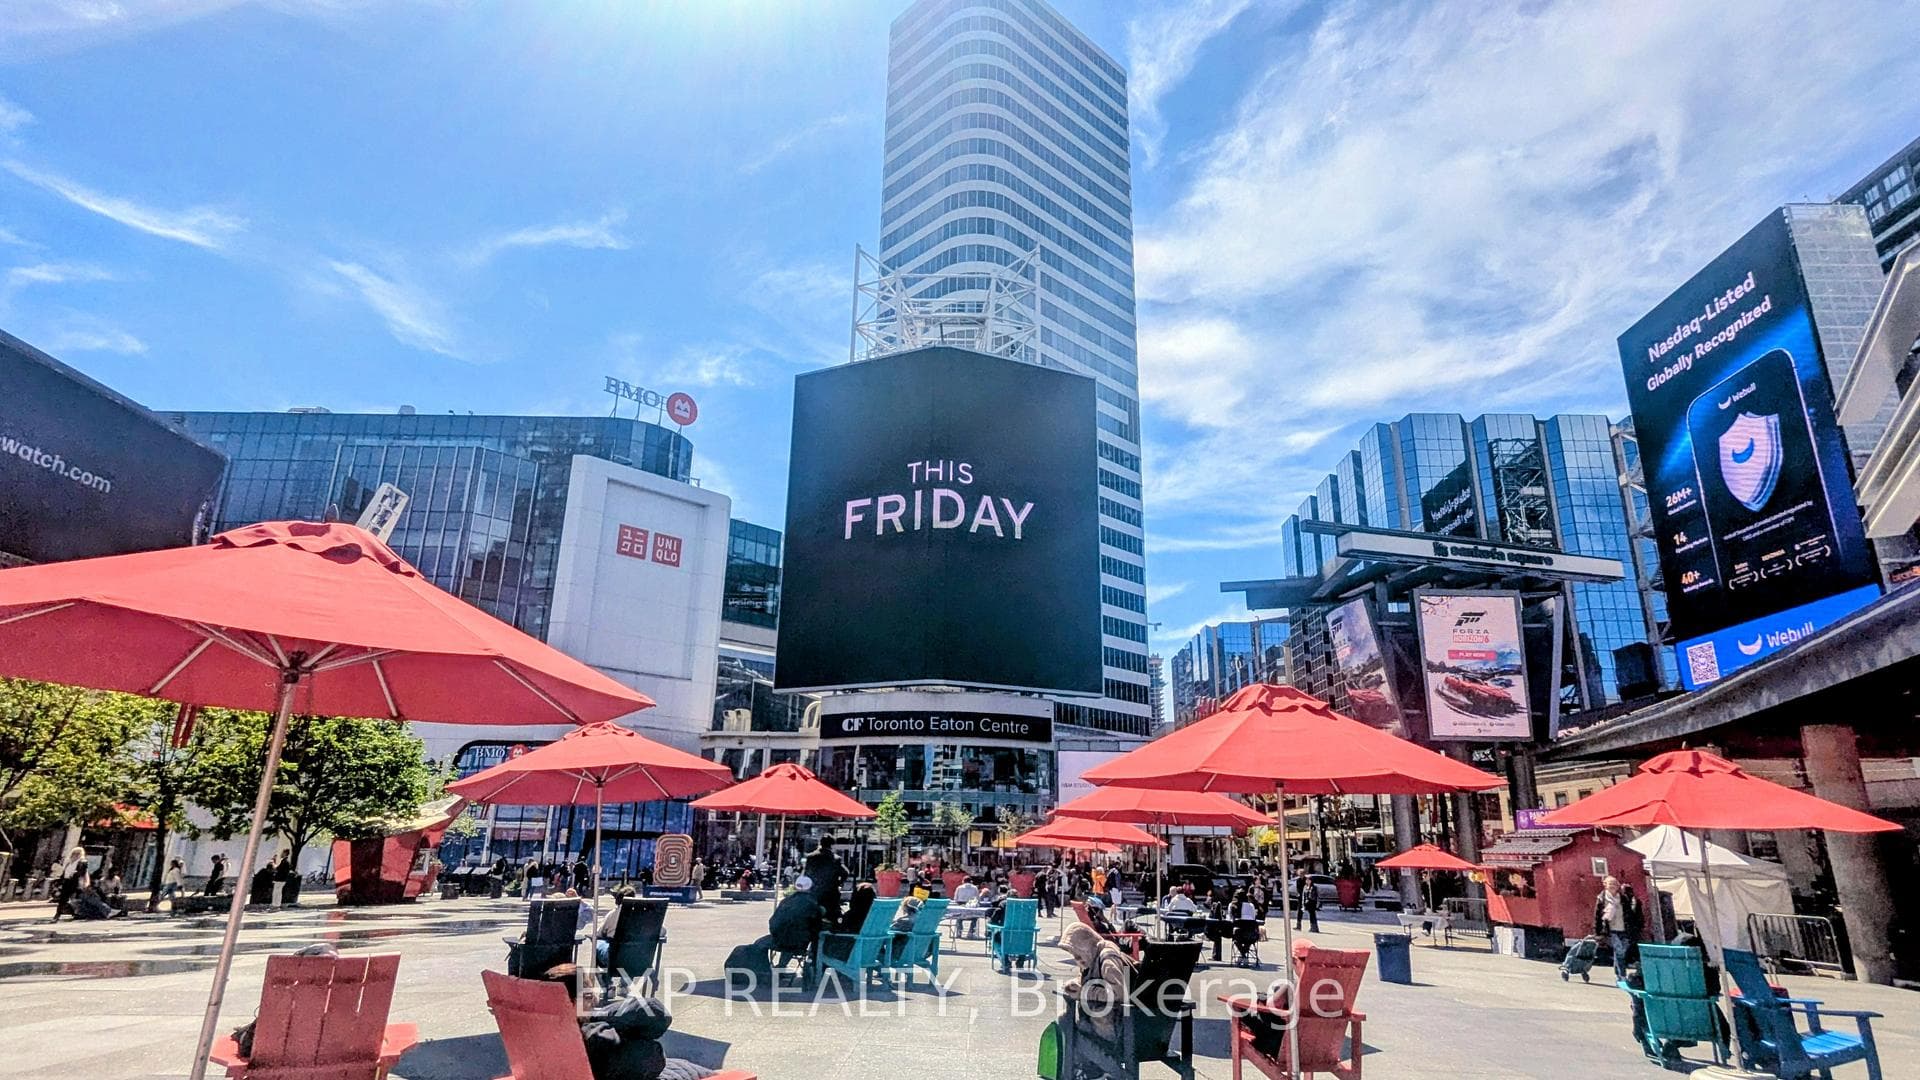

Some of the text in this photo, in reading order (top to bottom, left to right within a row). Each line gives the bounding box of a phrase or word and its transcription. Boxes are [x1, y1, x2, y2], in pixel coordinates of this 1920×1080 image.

[1648, 271, 1756, 363] Nasdaq-Listed
[1647, 294, 1772, 391] Globally Recognized
[603, 375, 661, 408] BMO
[0, 436, 111, 493] watch.com
[907, 459, 974, 484] THIS
[1665, 487, 1692, 507] 26M+
[844, 488, 1035, 540] FRIDAY
[656, 536, 678, 551] UNI
[1673, 531, 1688, 546] 14
[655, 548, 678, 563] QLO
[1681, 570, 1701, 585] 40+
[1765, 621, 1814, 648] Webull
[842, 716, 1029, 734] CF Toronto Eaton Centre
[475, 747, 506, 758] BMO
